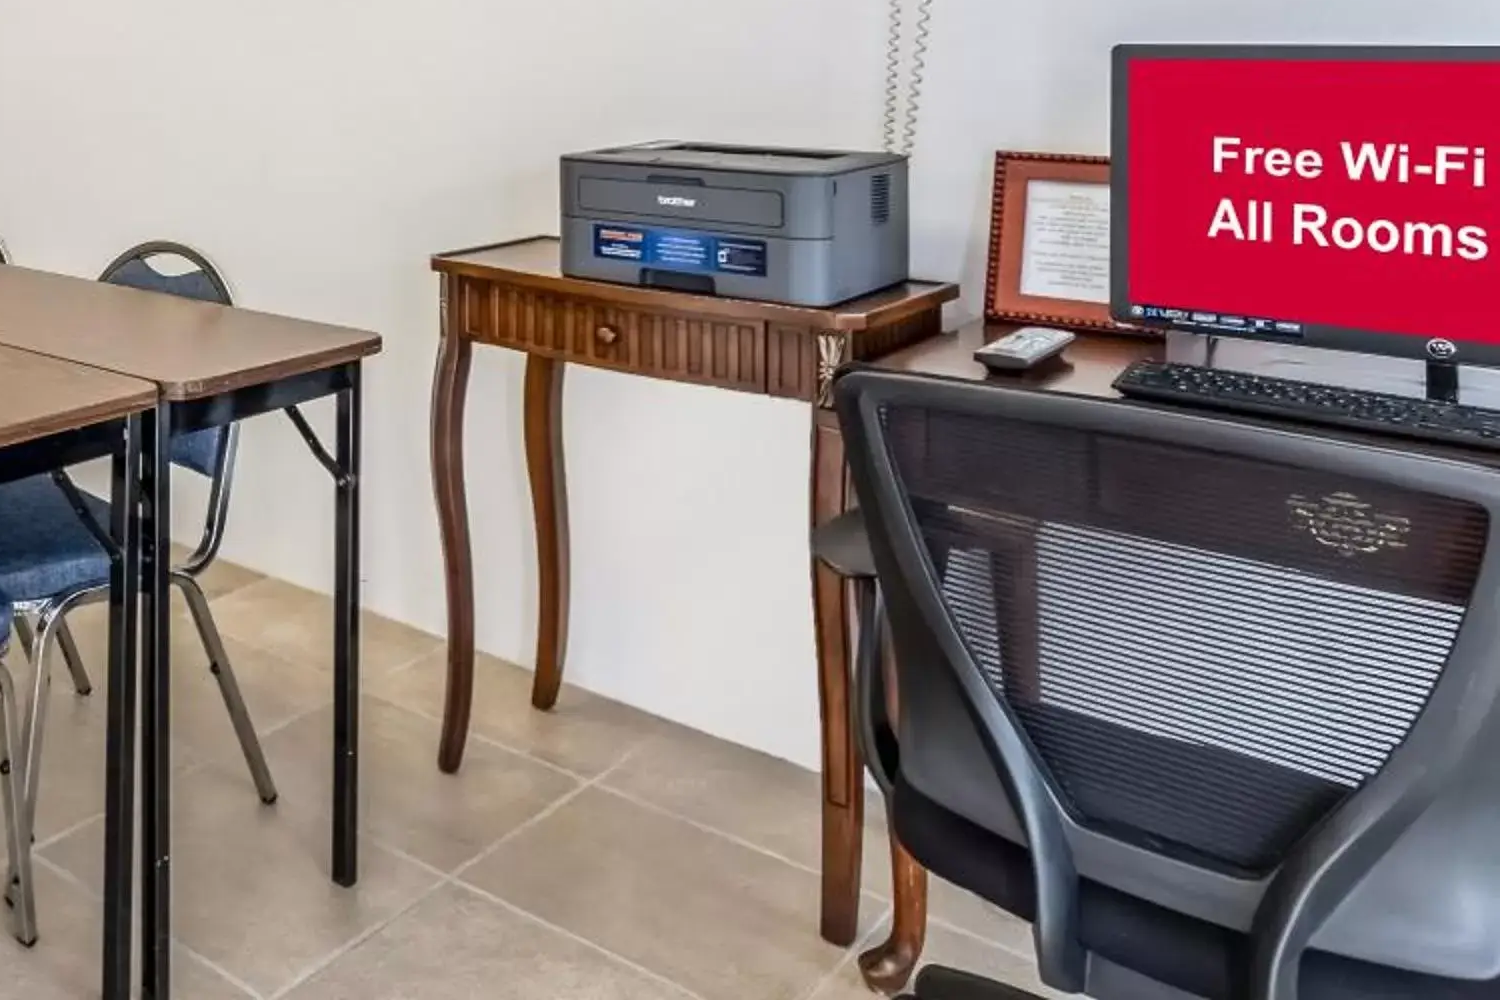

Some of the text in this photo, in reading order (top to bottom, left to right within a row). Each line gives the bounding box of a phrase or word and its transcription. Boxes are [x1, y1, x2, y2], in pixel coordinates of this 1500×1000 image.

[1212, 137, 1486, 187] Free Wi-Fi
[1207, 200, 1489, 260] All Rooms
